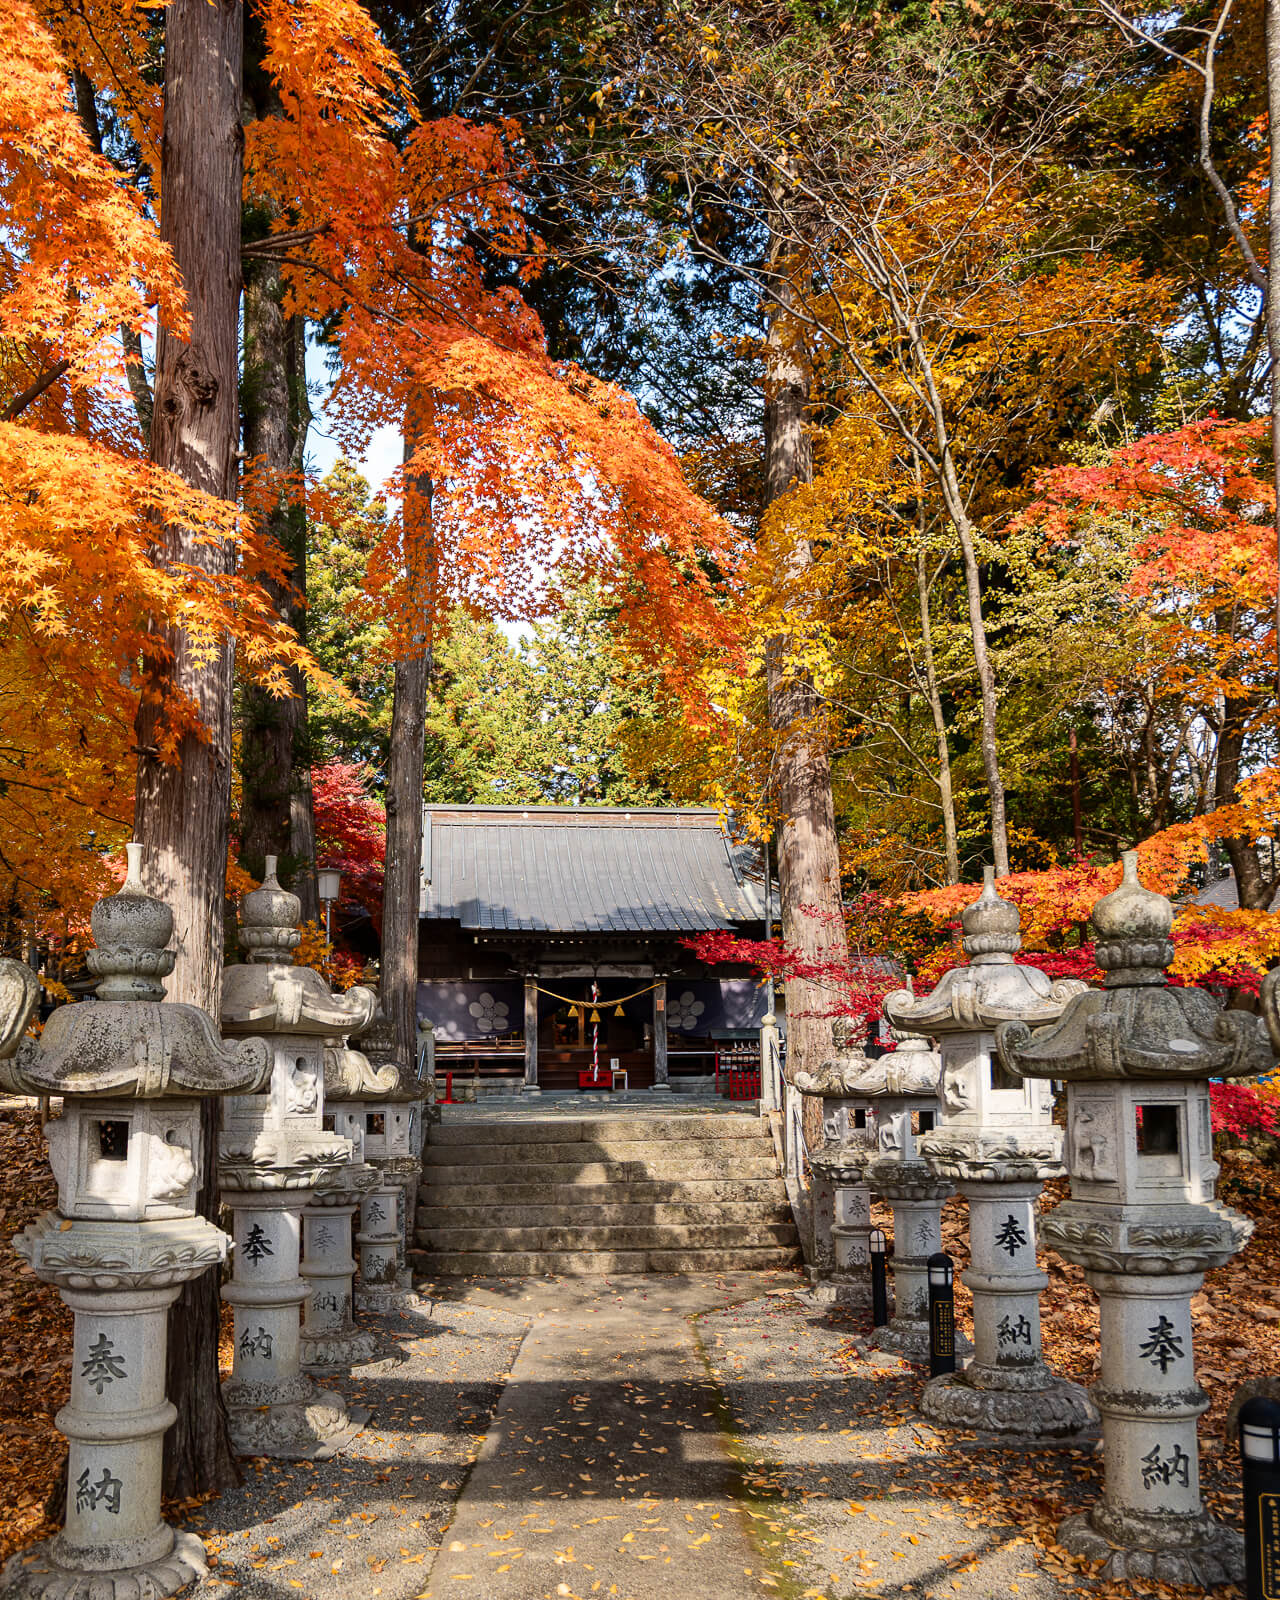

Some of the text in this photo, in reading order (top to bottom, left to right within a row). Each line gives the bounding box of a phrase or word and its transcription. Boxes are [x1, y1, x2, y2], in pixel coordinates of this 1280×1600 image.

[239, 1224, 274, 1361] 奉納
[995, 1215, 1031, 1348] 奉納
[76, 1333, 128, 1514] 奉納
[1139, 1315, 1189, 1490] 奉納
